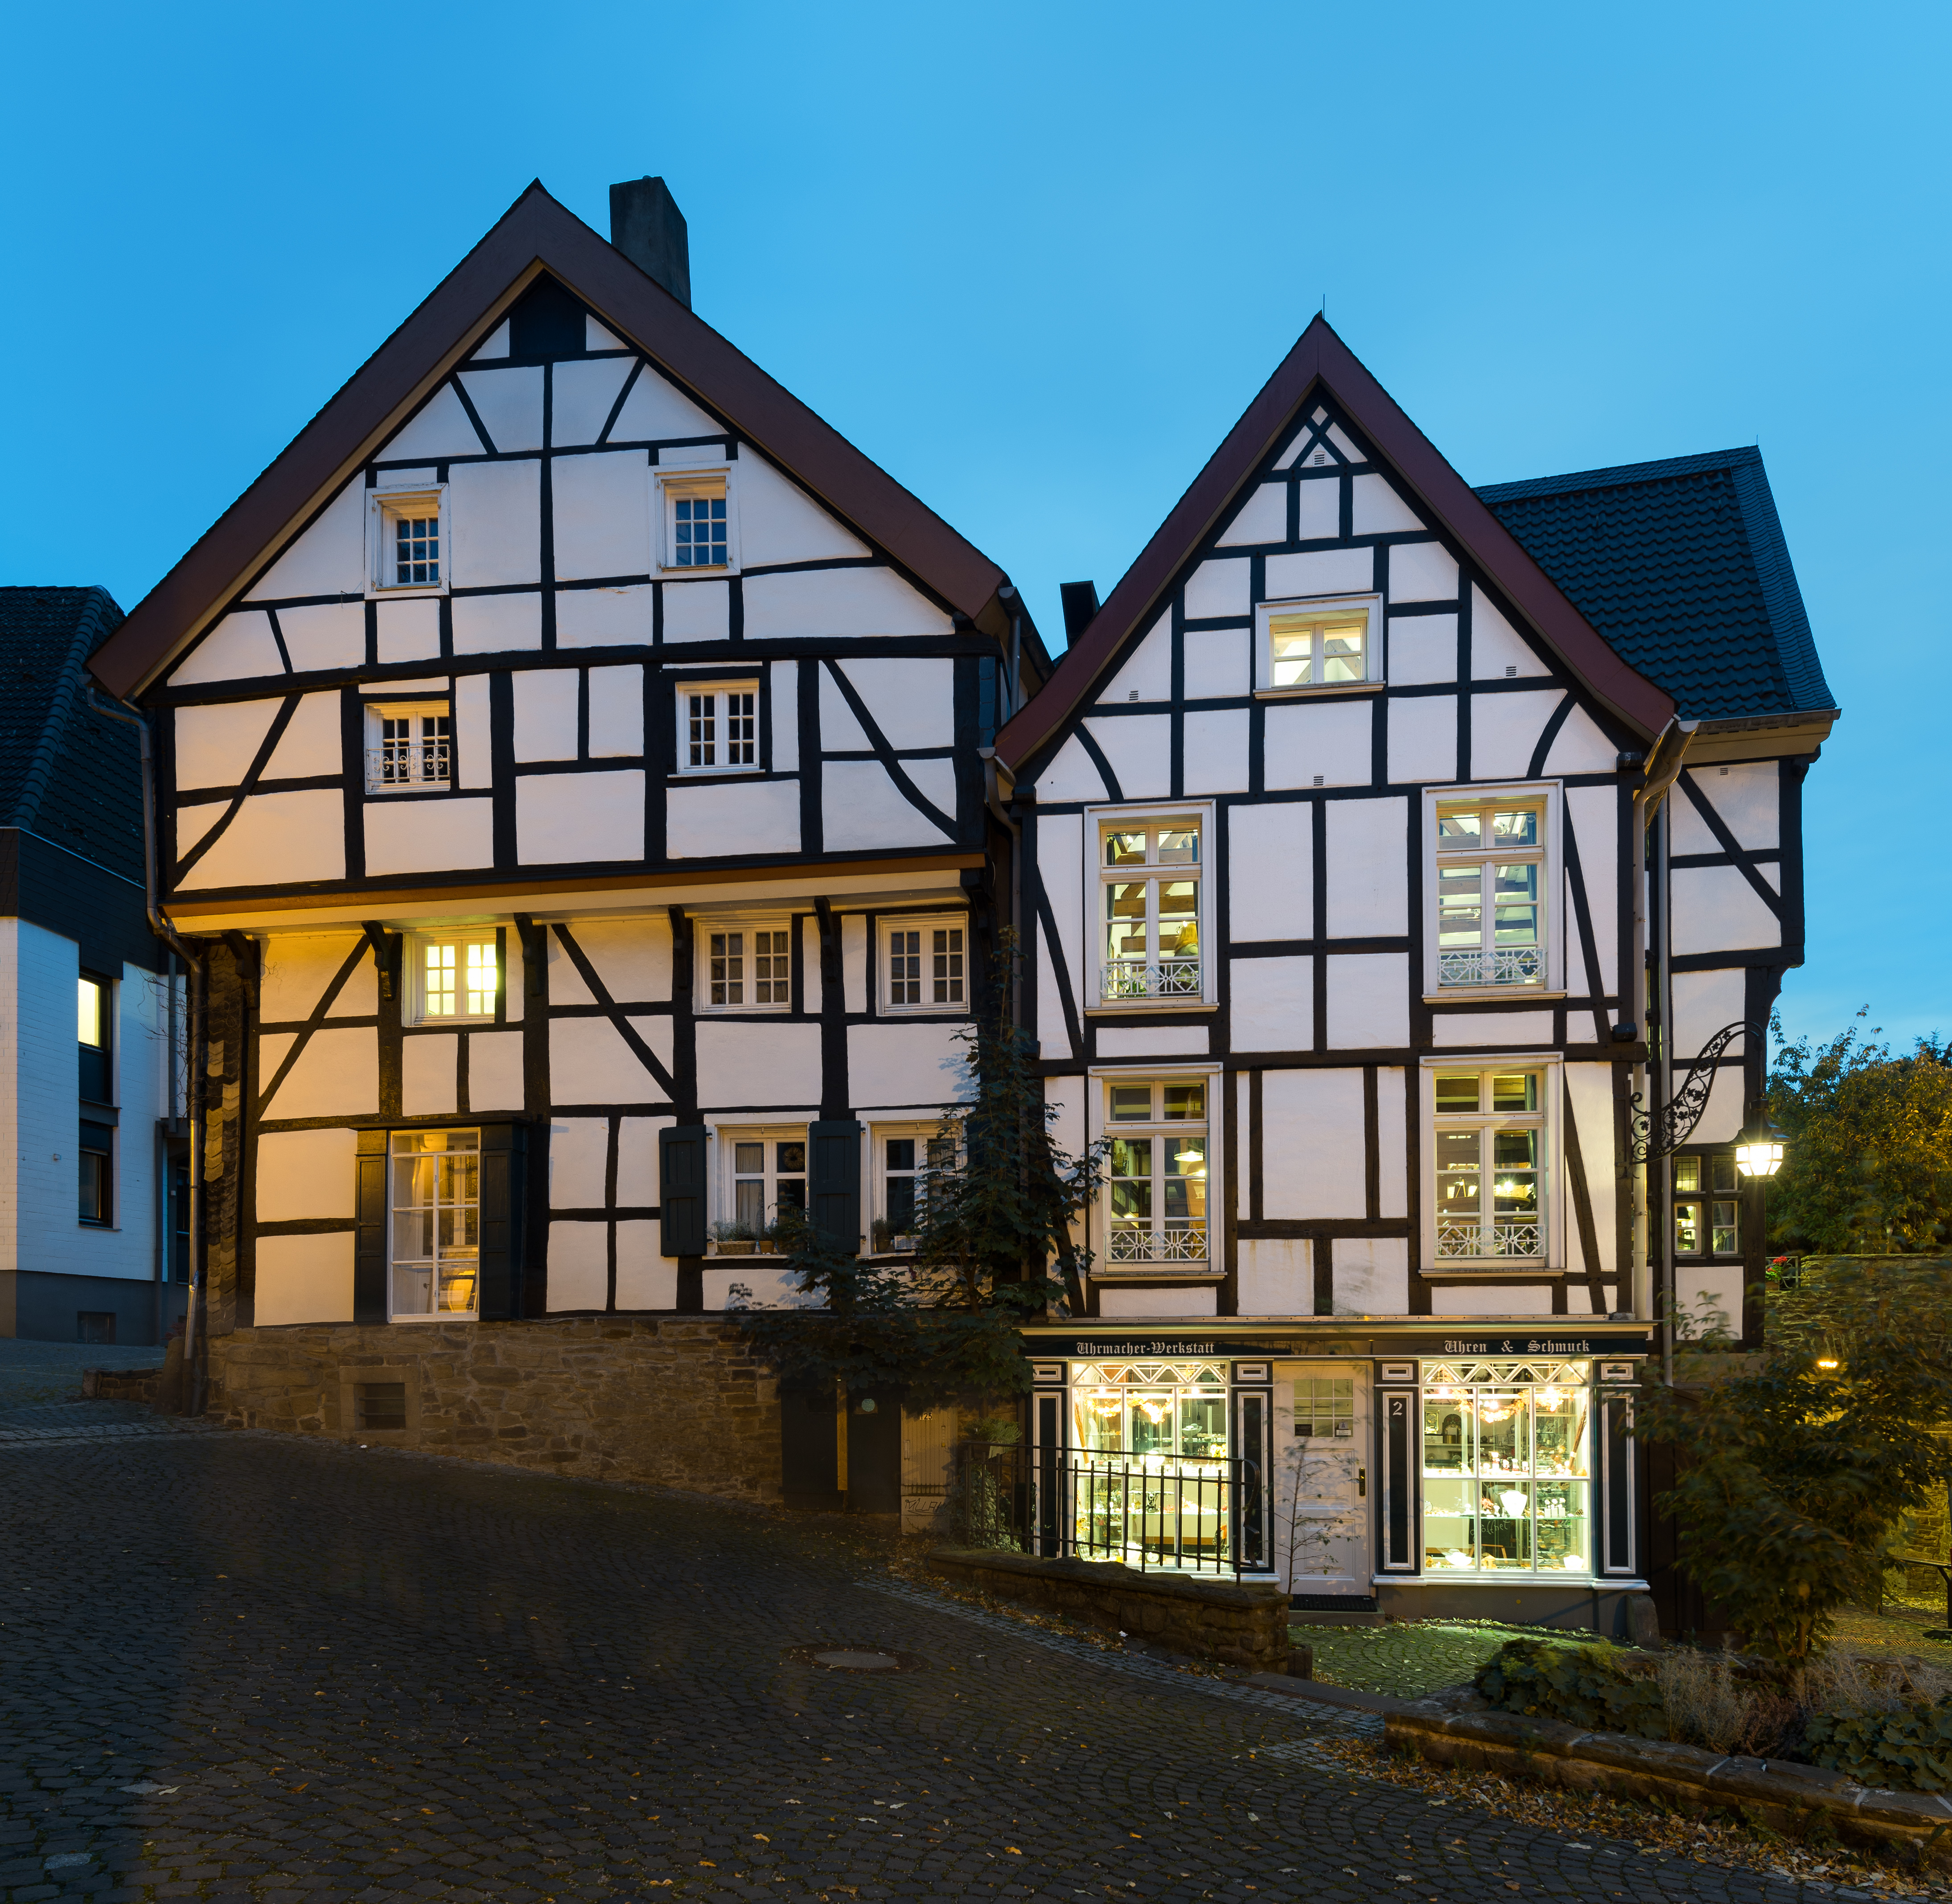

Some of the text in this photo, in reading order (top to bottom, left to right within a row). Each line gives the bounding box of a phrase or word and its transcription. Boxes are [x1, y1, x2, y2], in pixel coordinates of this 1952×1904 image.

[1077, 1341, 1215, 1356] Uhrmacher-Werkstatt
[1444, 1340, 1590, 1354] Uhren & Schmuck
[1393, 1401, 1402, 1415] 2
